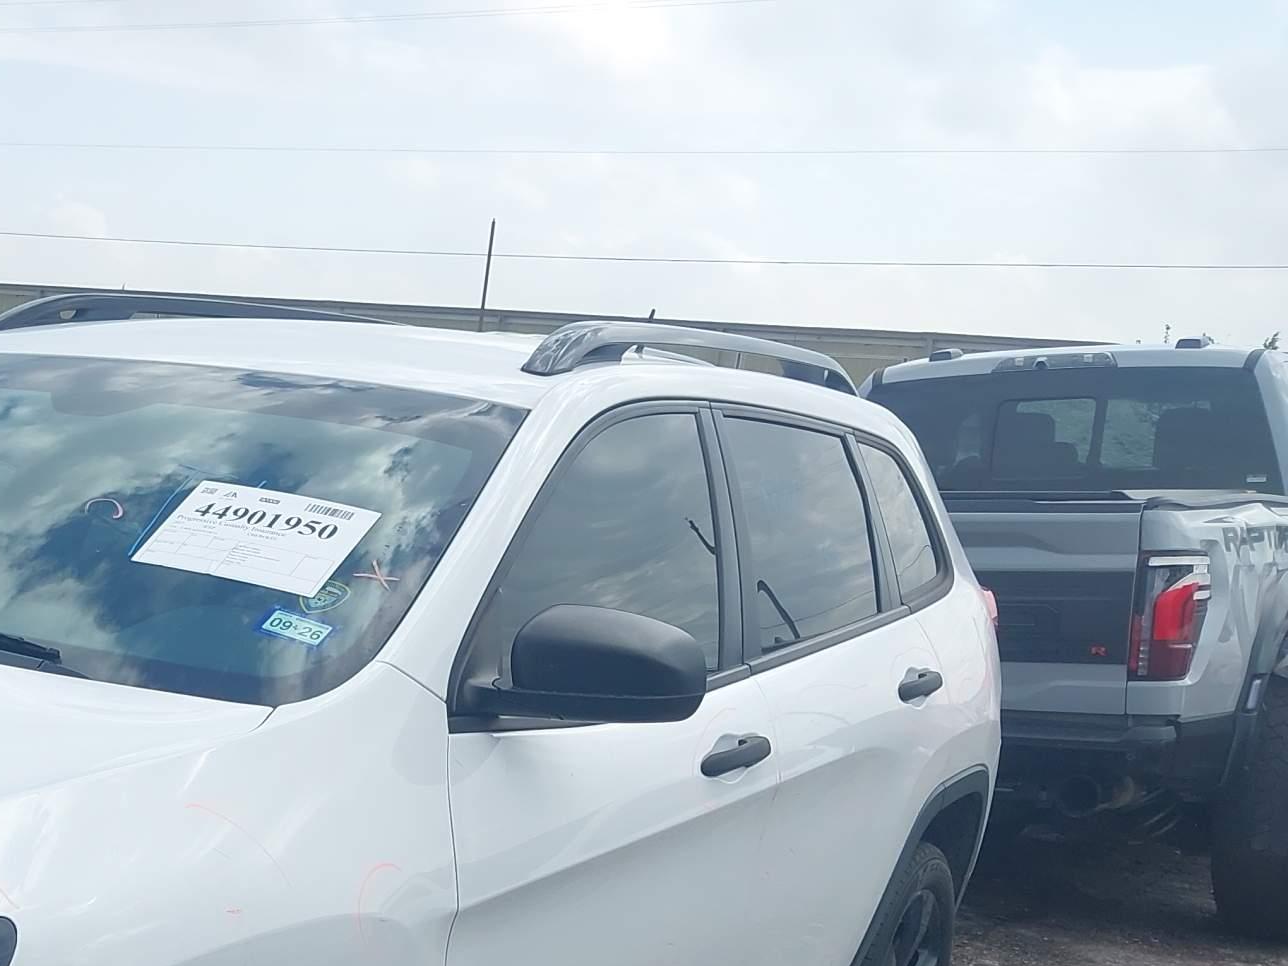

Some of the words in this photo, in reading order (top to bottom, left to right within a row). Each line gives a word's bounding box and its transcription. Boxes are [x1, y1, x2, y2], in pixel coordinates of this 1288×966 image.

[194, 502, 339, 540] 44901950
[269, 617, 293, 631] 09
[296, 626, 324, 641] 26
